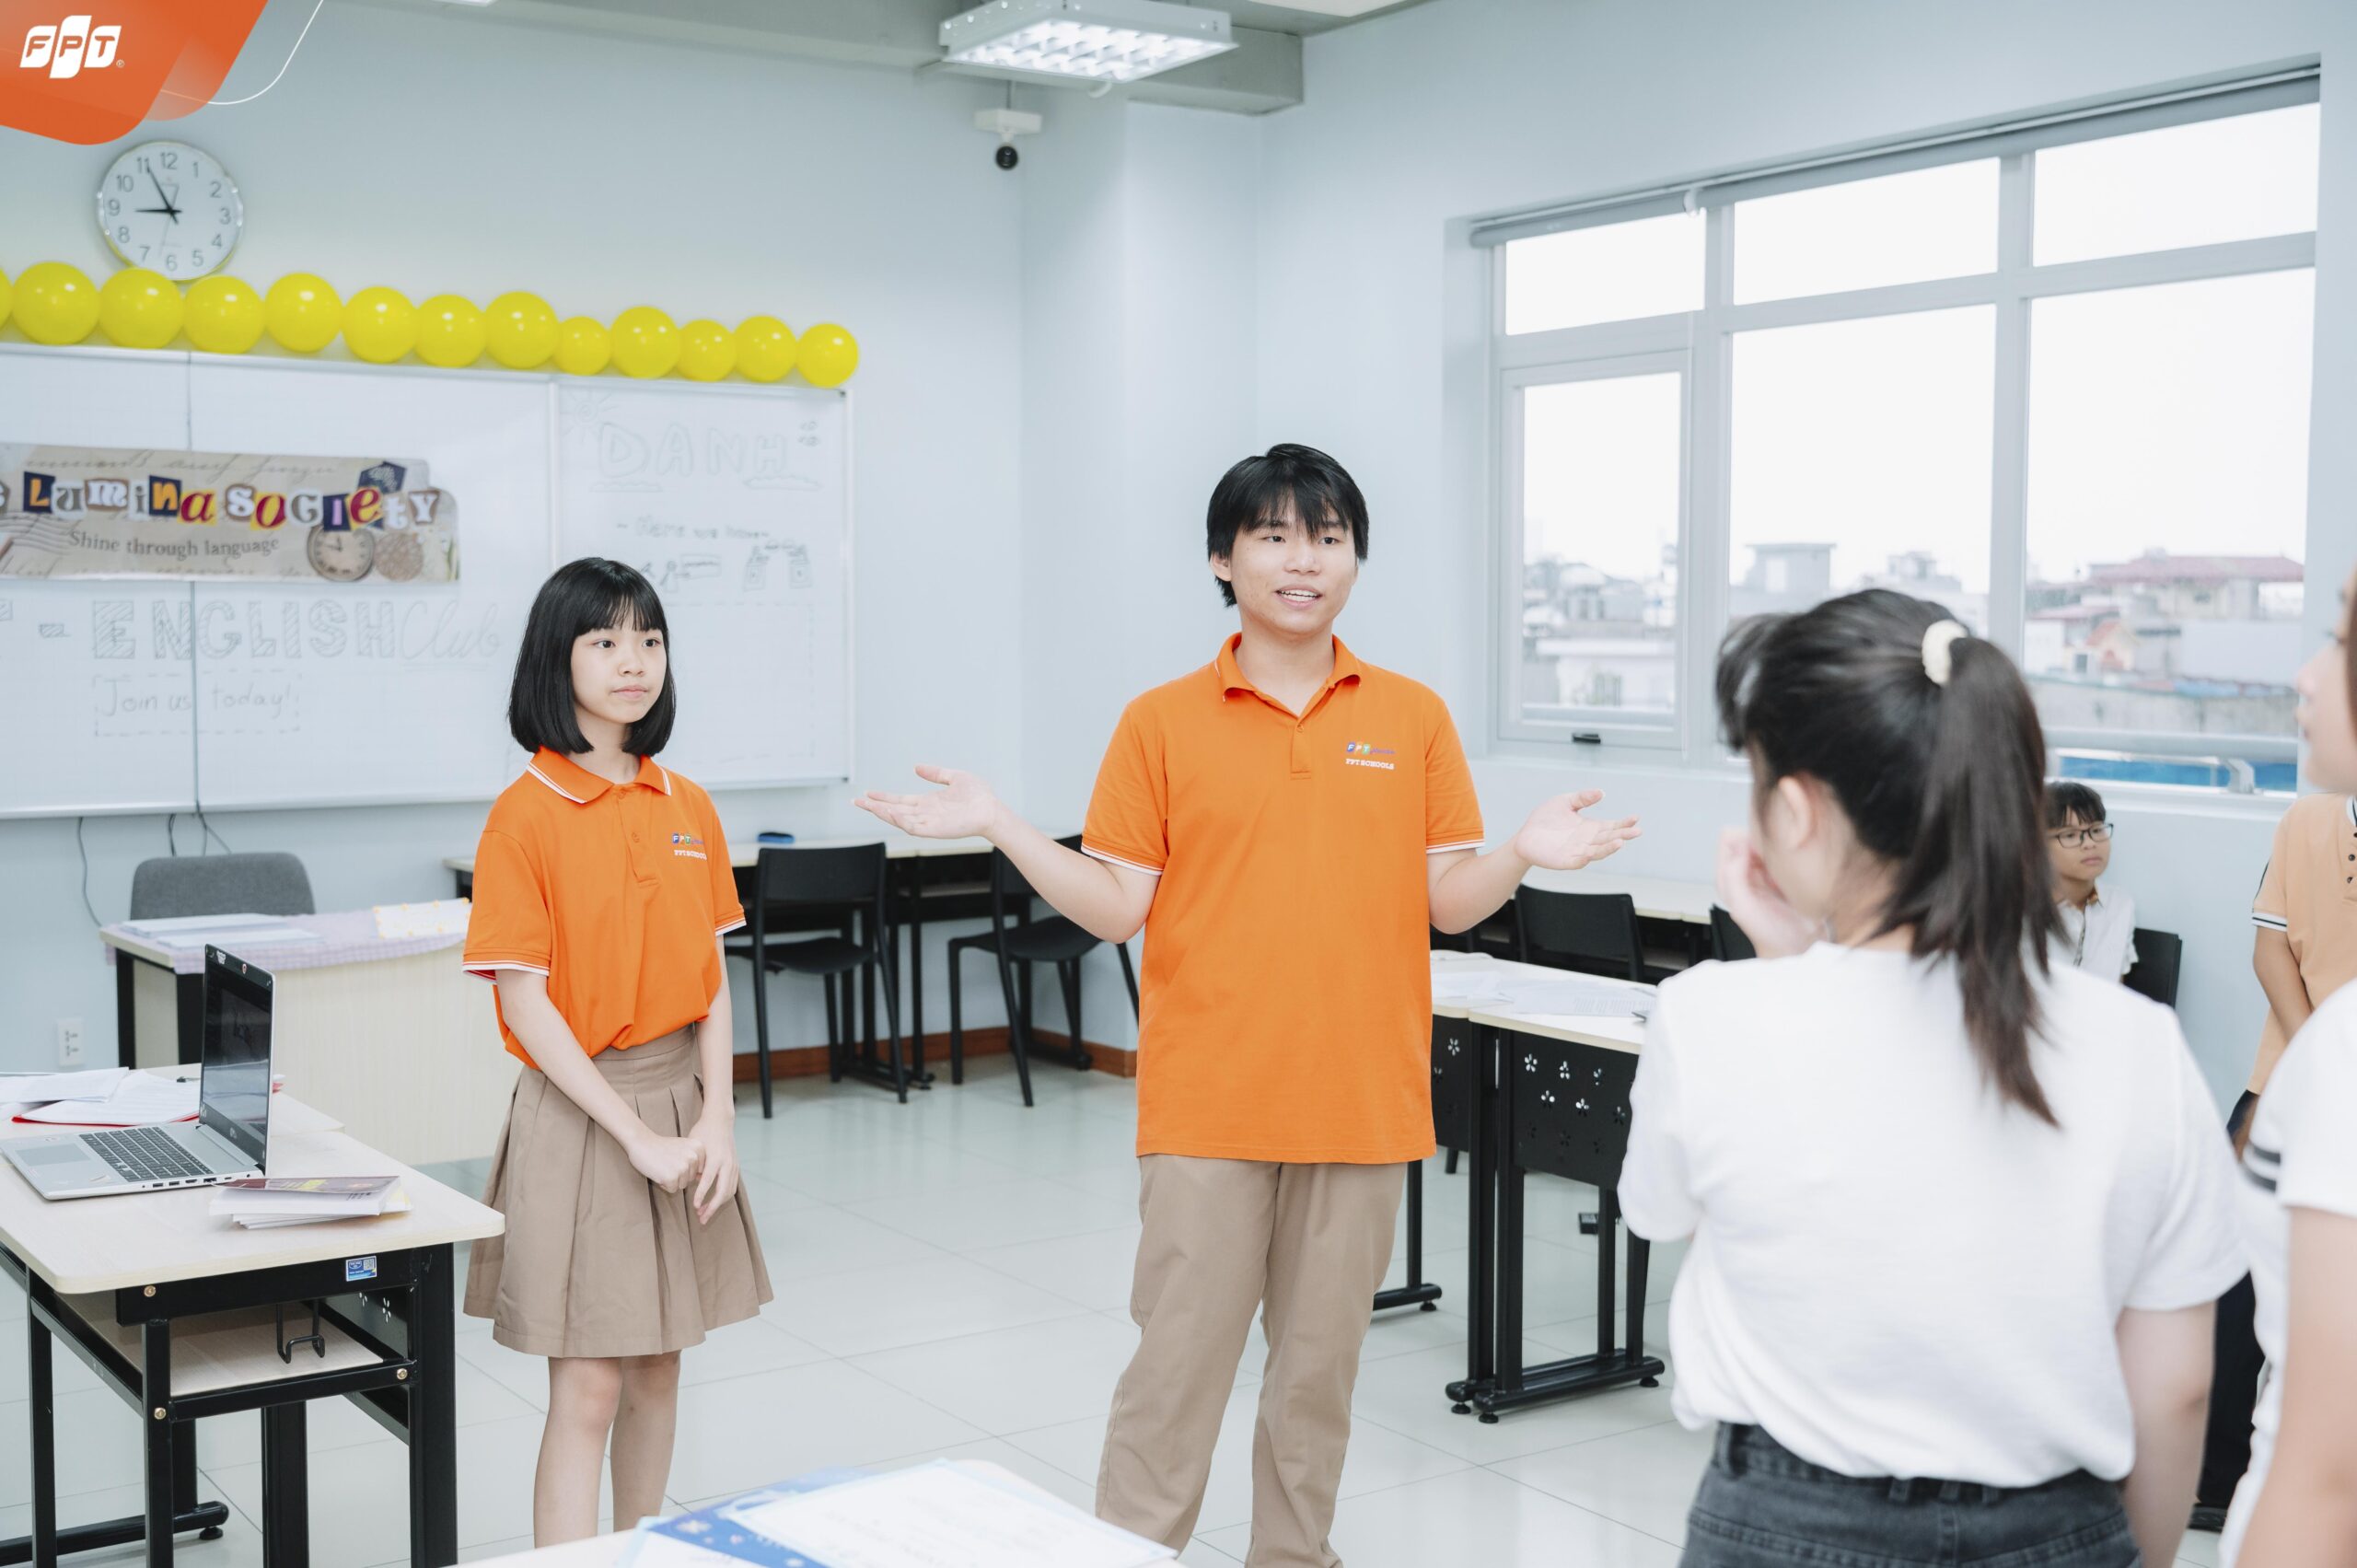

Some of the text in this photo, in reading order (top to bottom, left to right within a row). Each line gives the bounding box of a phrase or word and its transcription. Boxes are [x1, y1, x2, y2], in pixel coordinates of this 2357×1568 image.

[136, 157, 151, 175] 11
[159, 151, 179, 170] 12
[192, 161, 200, 179] 1
[116, 175, 134, 193] 10
[209, 181, 223, 199] 2
[107, 199, 121, 217] 9
[219, 207, 231, 226] 3
[117, 226, 131, 244] 8
[210, 233, 224, 250] 4
[138, 245, 151, 262] 7
[166, 253, 179, 272] 6
[192, 249, 204, 267] 5
[598, 421, 789, 478] DANH
[69, 529, 280, 562] Shine through language
[92, 598, 396, 660] ENGLISH
[401, 598, 503, 659] Club
[100, 679, 159, 718] Join
[168, 691, 192, 712] us
